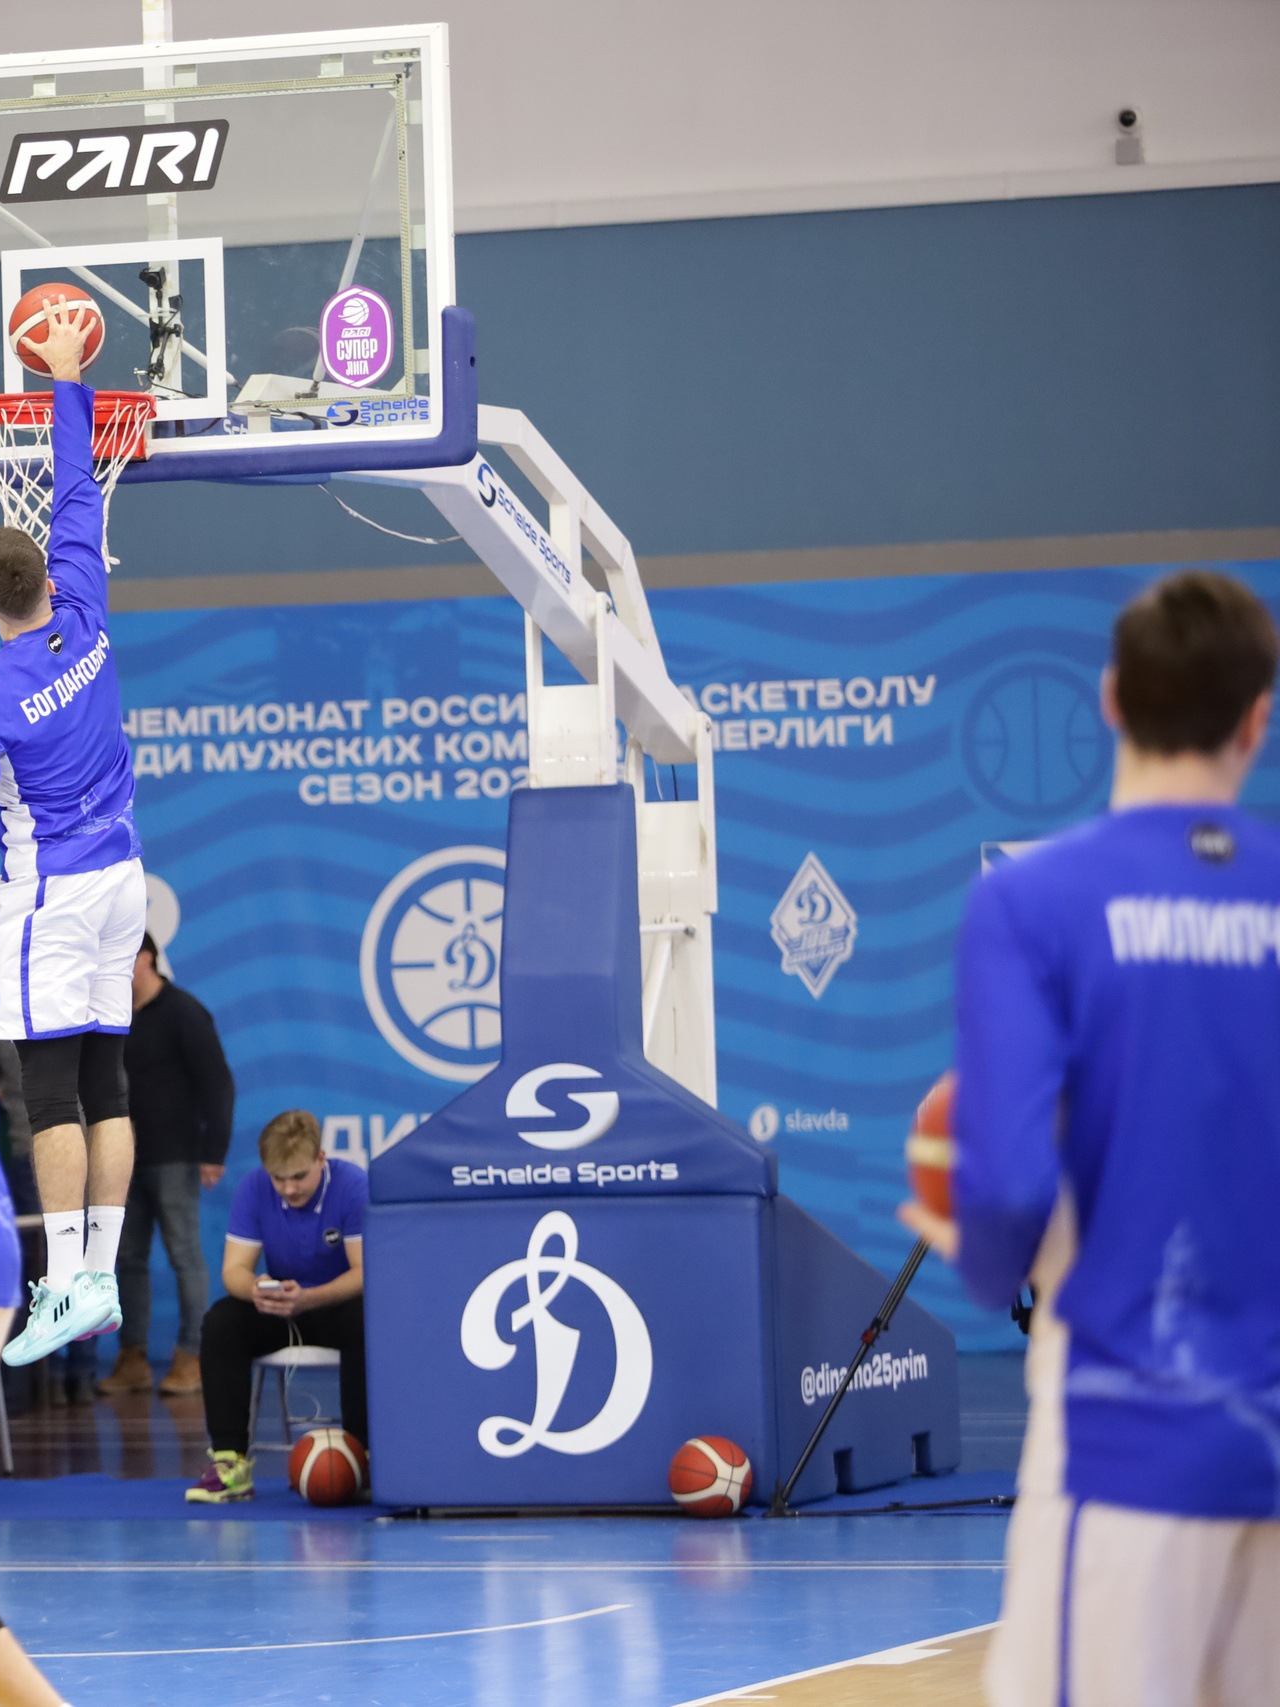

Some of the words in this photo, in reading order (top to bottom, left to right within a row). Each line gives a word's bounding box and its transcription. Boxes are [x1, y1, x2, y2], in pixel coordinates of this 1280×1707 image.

[7, 128, 219, 195] PARI
[342, 328, 370, 337] PARI
[336, 338, 378, 361] СУПЕР
[345, 360, 369, 376] ЛИГА
[360, 398, 429, 412] Schelde
[360, 410, 429, 426] Sports
[19, 630, 110, 725] БОГДАНОВИЧ
[121, 700, 370, 738] ЧЕМПИОНАТ
[381, 692, 527, 730] РОССИ
[202, 734, 423, 773] МУЖСКИХ
[434, 728, 528, 764] КОМ
[298, 770, 443, 806] СЕЗОН
[784, 1107, 849, 1133] slavda
[451, 1163, 571, 1186] Schelde
[577, 1160, 679, 1187] Sports
